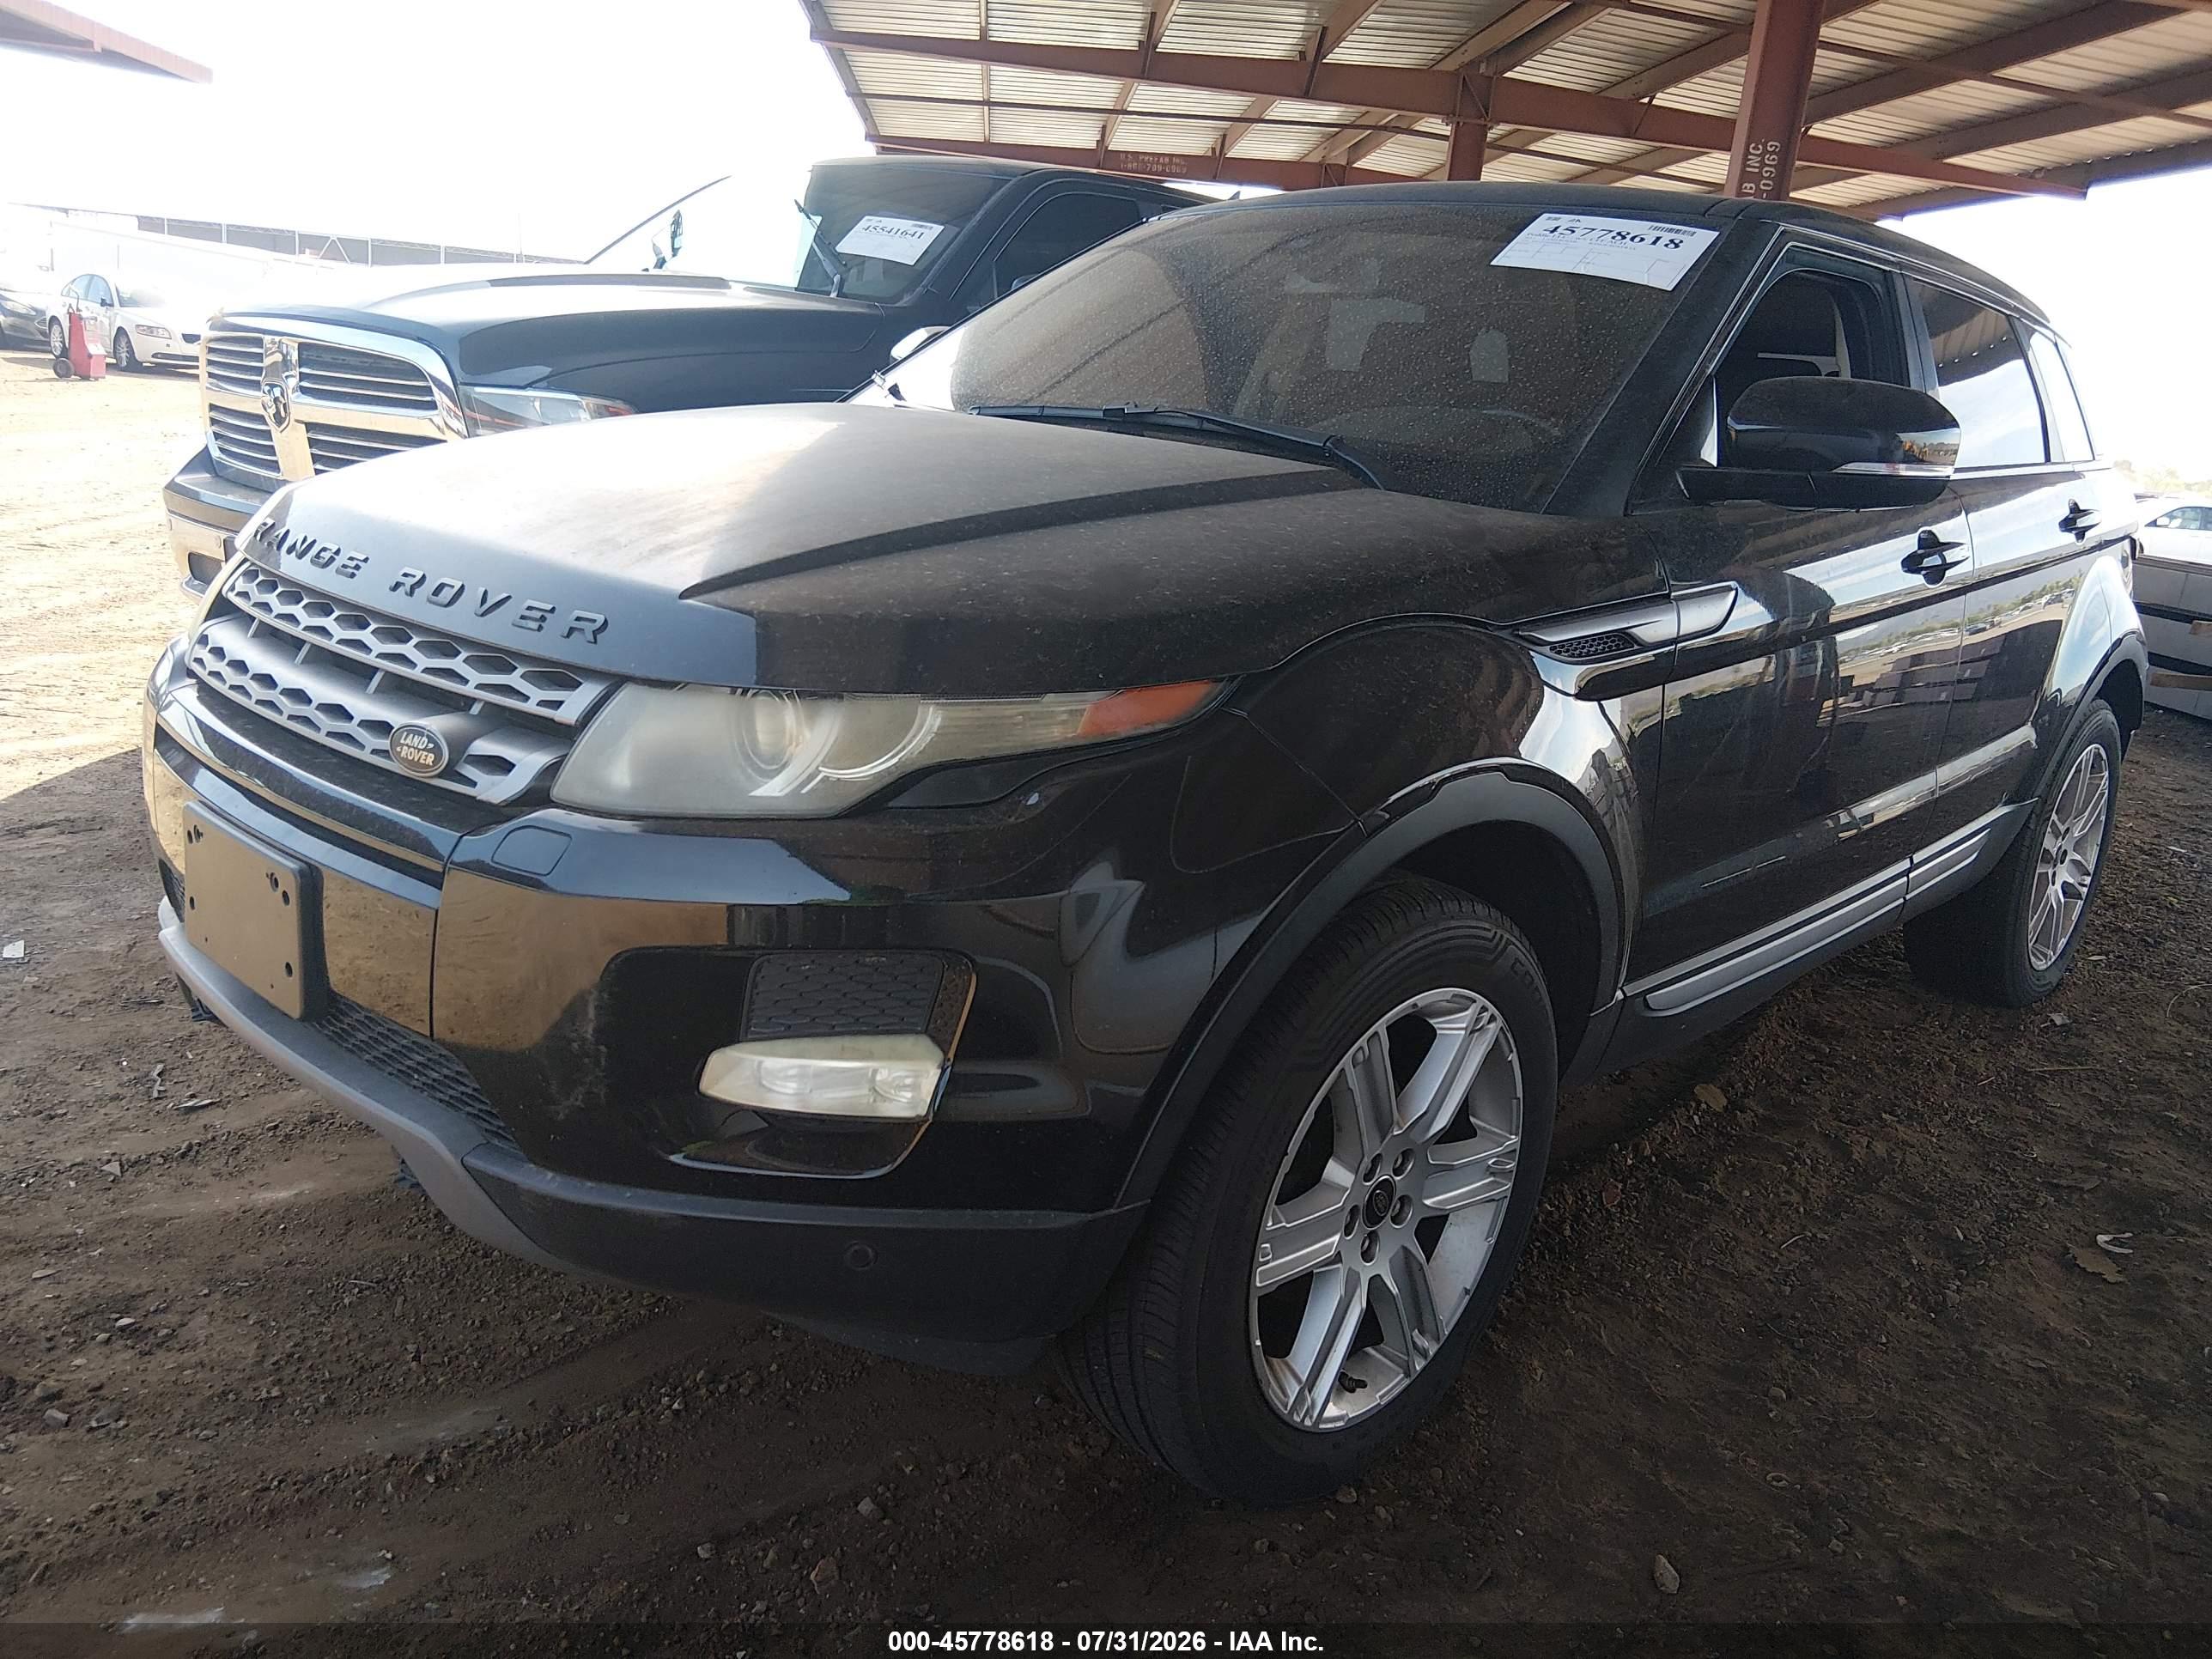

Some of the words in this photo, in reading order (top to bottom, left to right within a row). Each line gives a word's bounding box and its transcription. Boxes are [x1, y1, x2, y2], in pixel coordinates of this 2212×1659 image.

[1745, 138, 1765, 173] INC.
[862, 225, 925, 240] 45541641
[1542, 224, 1685, 250] 45778618
[253, 517, 370, 580] RANGE
[388, 566, 611, 645] ROVER
[399, 731, 428, 750] LAND
[400, 745, 435, 766] ROVER
